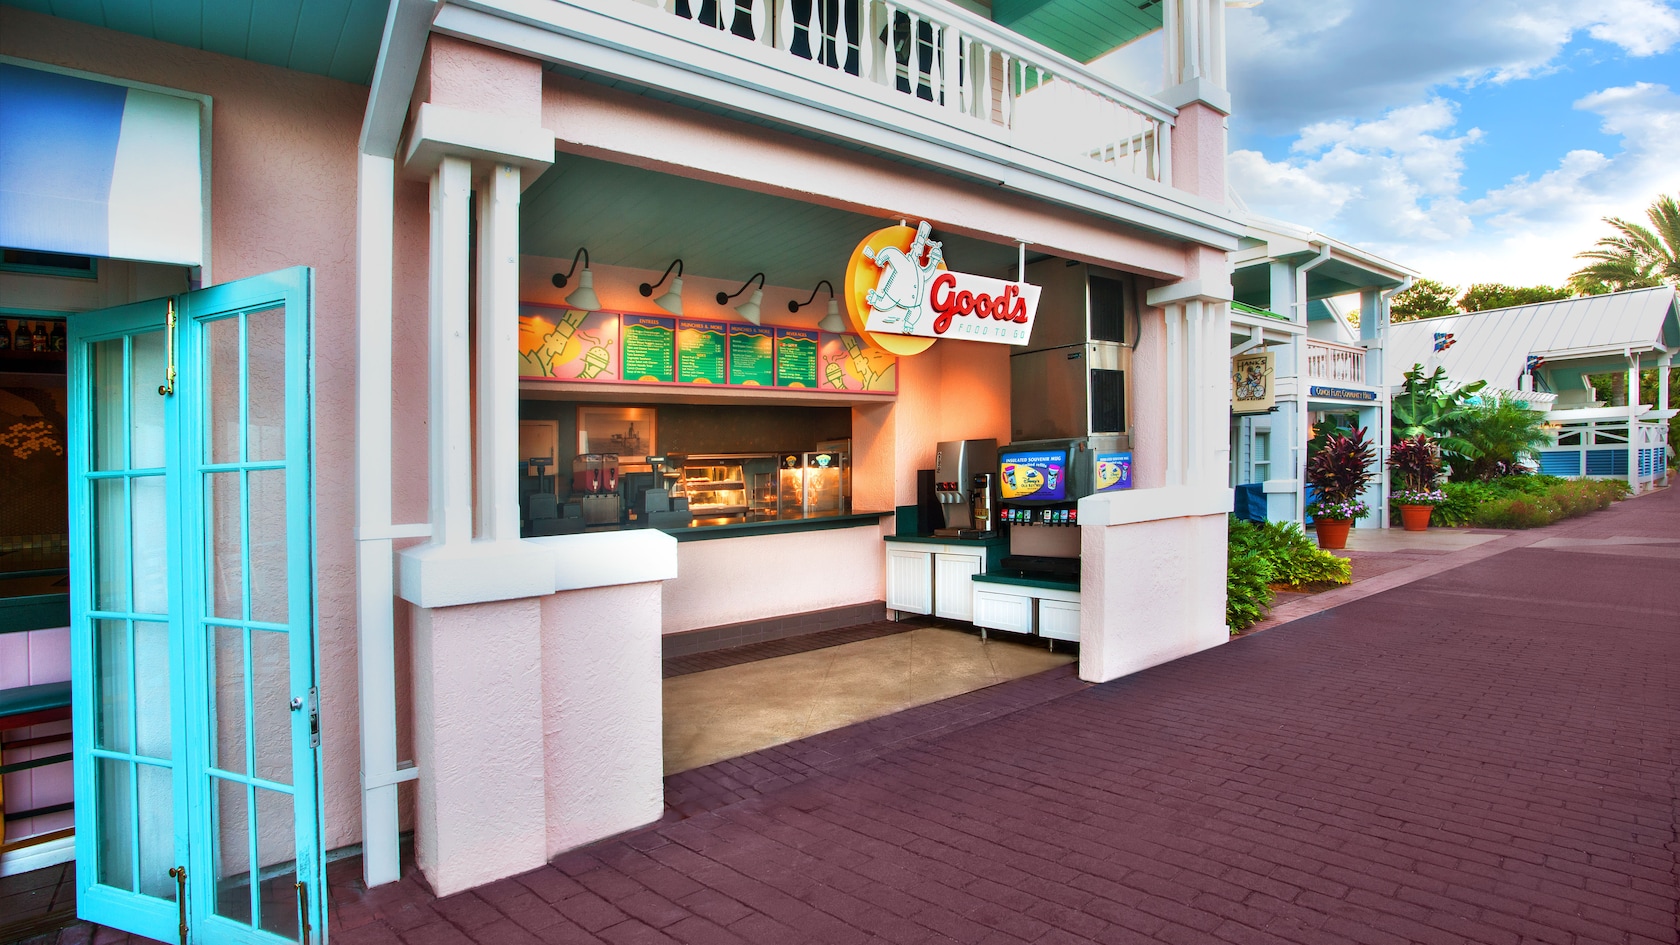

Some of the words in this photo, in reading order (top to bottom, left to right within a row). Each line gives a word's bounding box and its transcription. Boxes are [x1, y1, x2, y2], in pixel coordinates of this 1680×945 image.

[931, 273, 1028, 334] Good's
[958, 323, 988, 335] FOOD
[995, 327, 1006, 337] TO
[1013, 329, 1025, 339] GO
